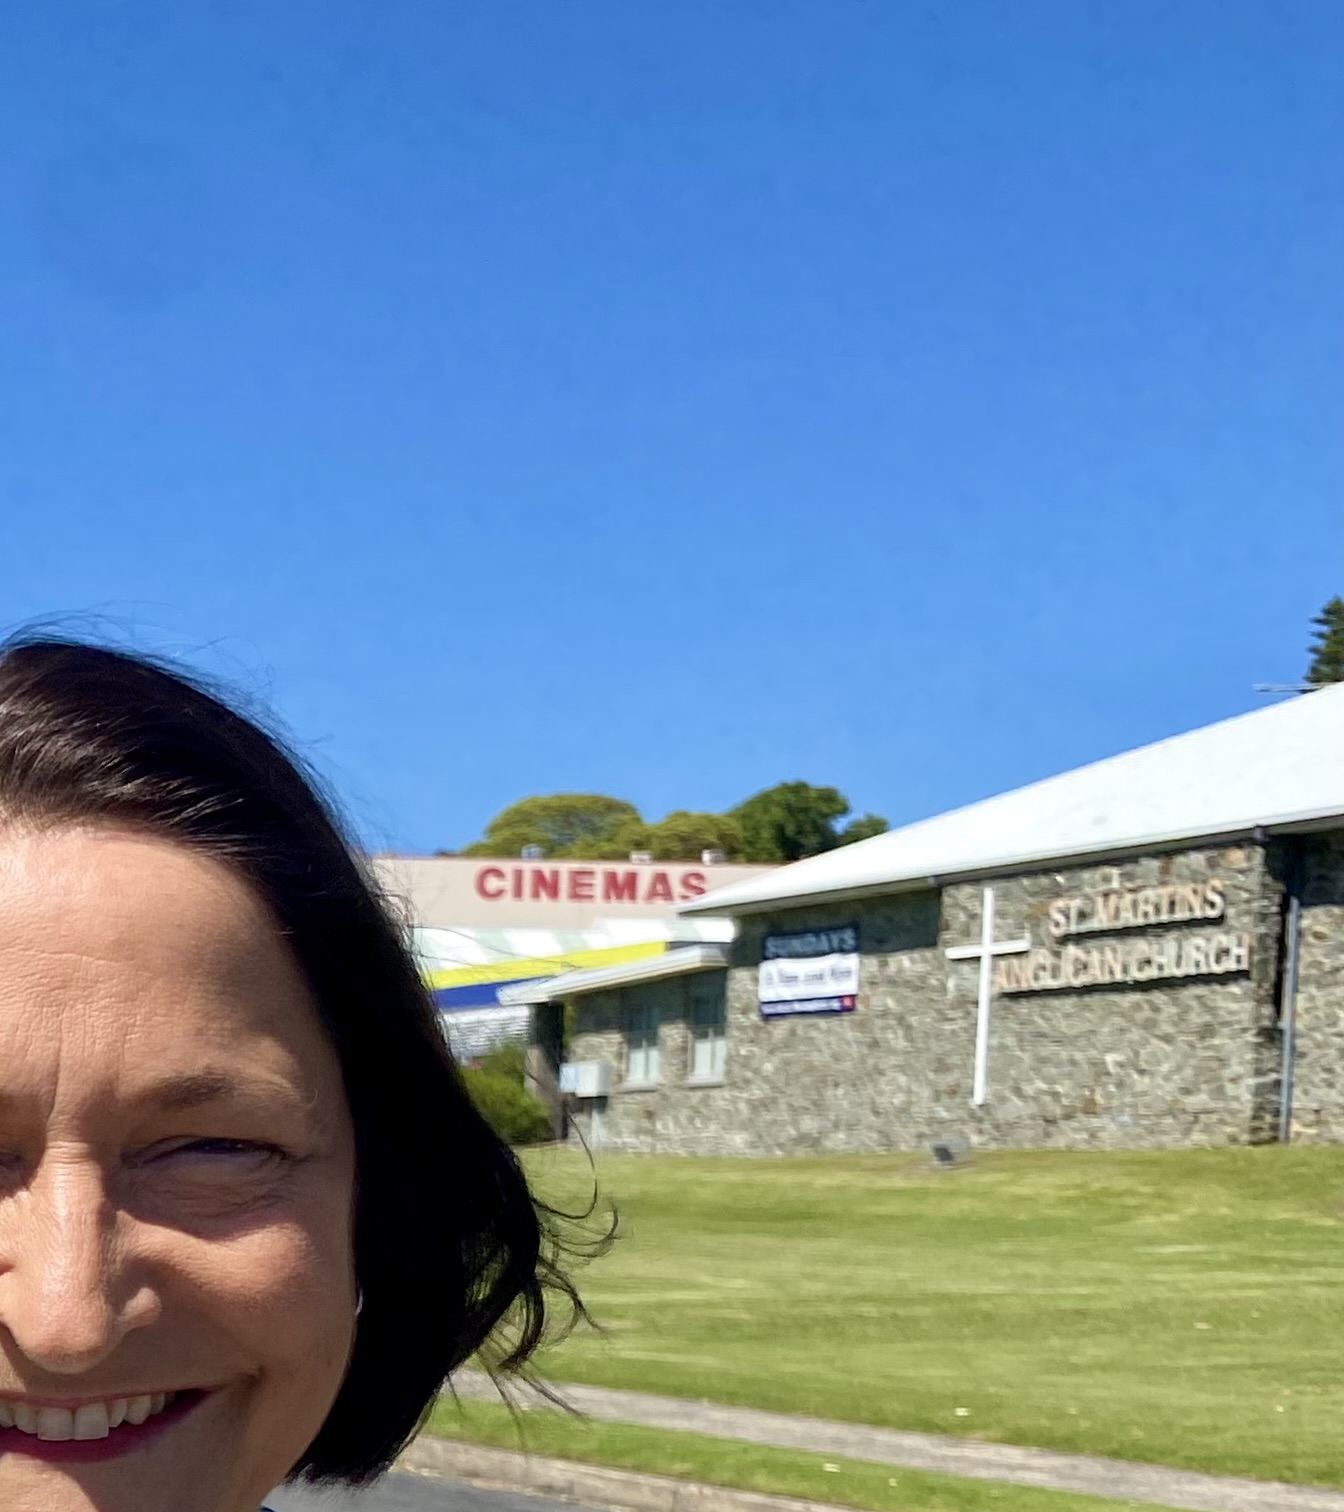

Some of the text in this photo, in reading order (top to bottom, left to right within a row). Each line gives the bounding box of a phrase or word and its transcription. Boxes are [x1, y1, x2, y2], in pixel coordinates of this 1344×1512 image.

[475, 868, 707, 902] CINEMAS
[1093, 880, 1226, 930] MARTINS
[994, 931, 1251, 990] ANGLICAN CHURCH
